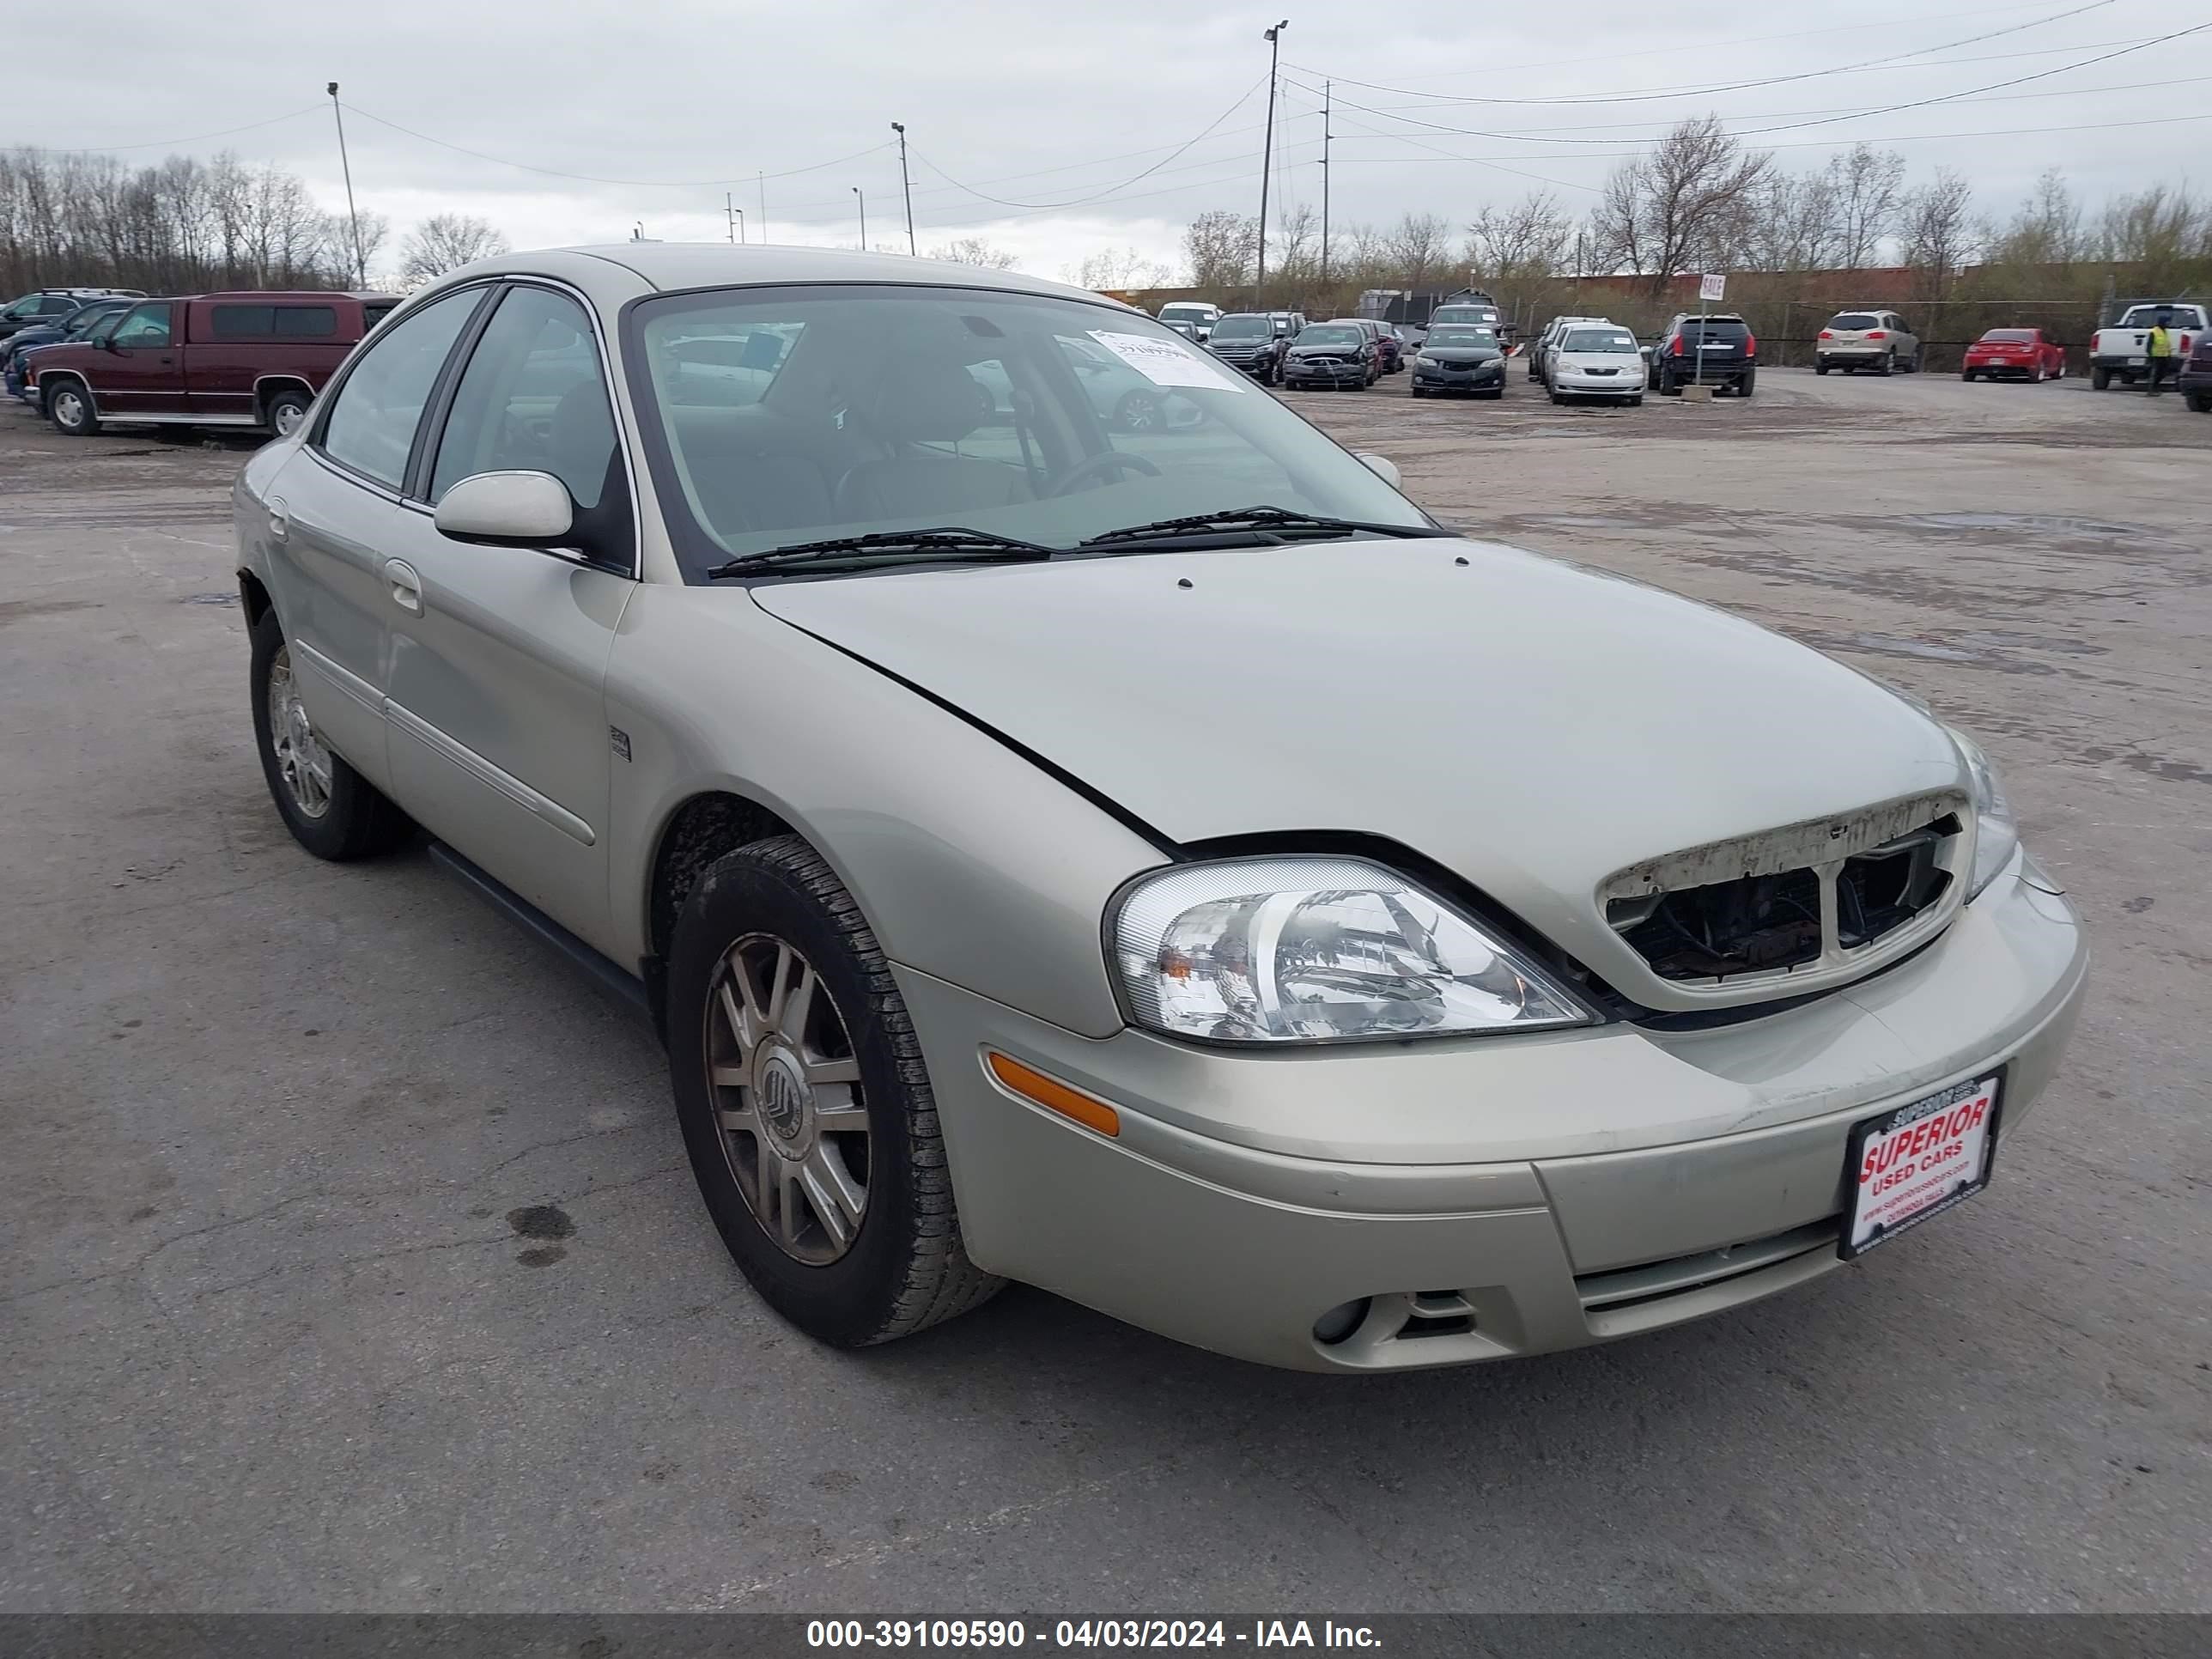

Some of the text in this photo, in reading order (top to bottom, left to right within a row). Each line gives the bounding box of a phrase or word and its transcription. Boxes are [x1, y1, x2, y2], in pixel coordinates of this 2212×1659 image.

[1859, 1097, 1989, 1184] SUPERIOR
[1871, 1139, 1964, 1197] USED CARS
